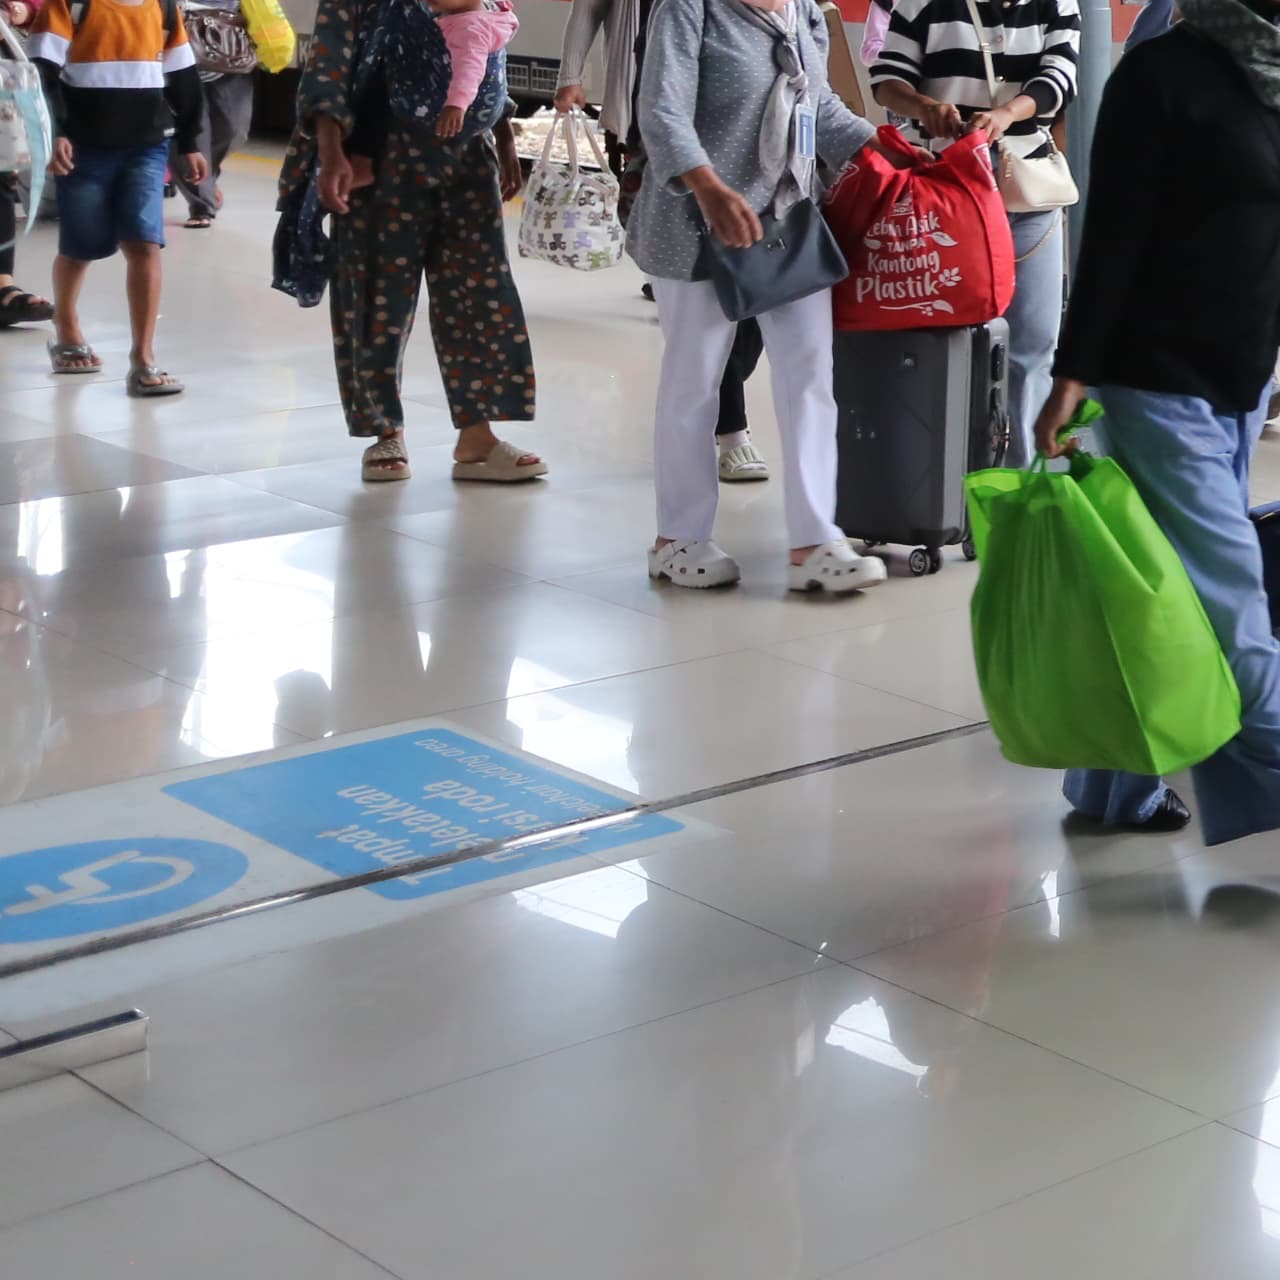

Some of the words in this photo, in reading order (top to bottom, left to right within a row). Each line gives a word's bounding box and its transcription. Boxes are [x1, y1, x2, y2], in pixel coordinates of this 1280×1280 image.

[867, 250, 940, 274] Kantong
[856, 271, 940, 303] Plastik
[423, 780, 511, 812] roda
[316, 823, 453, 886] Tmpat
